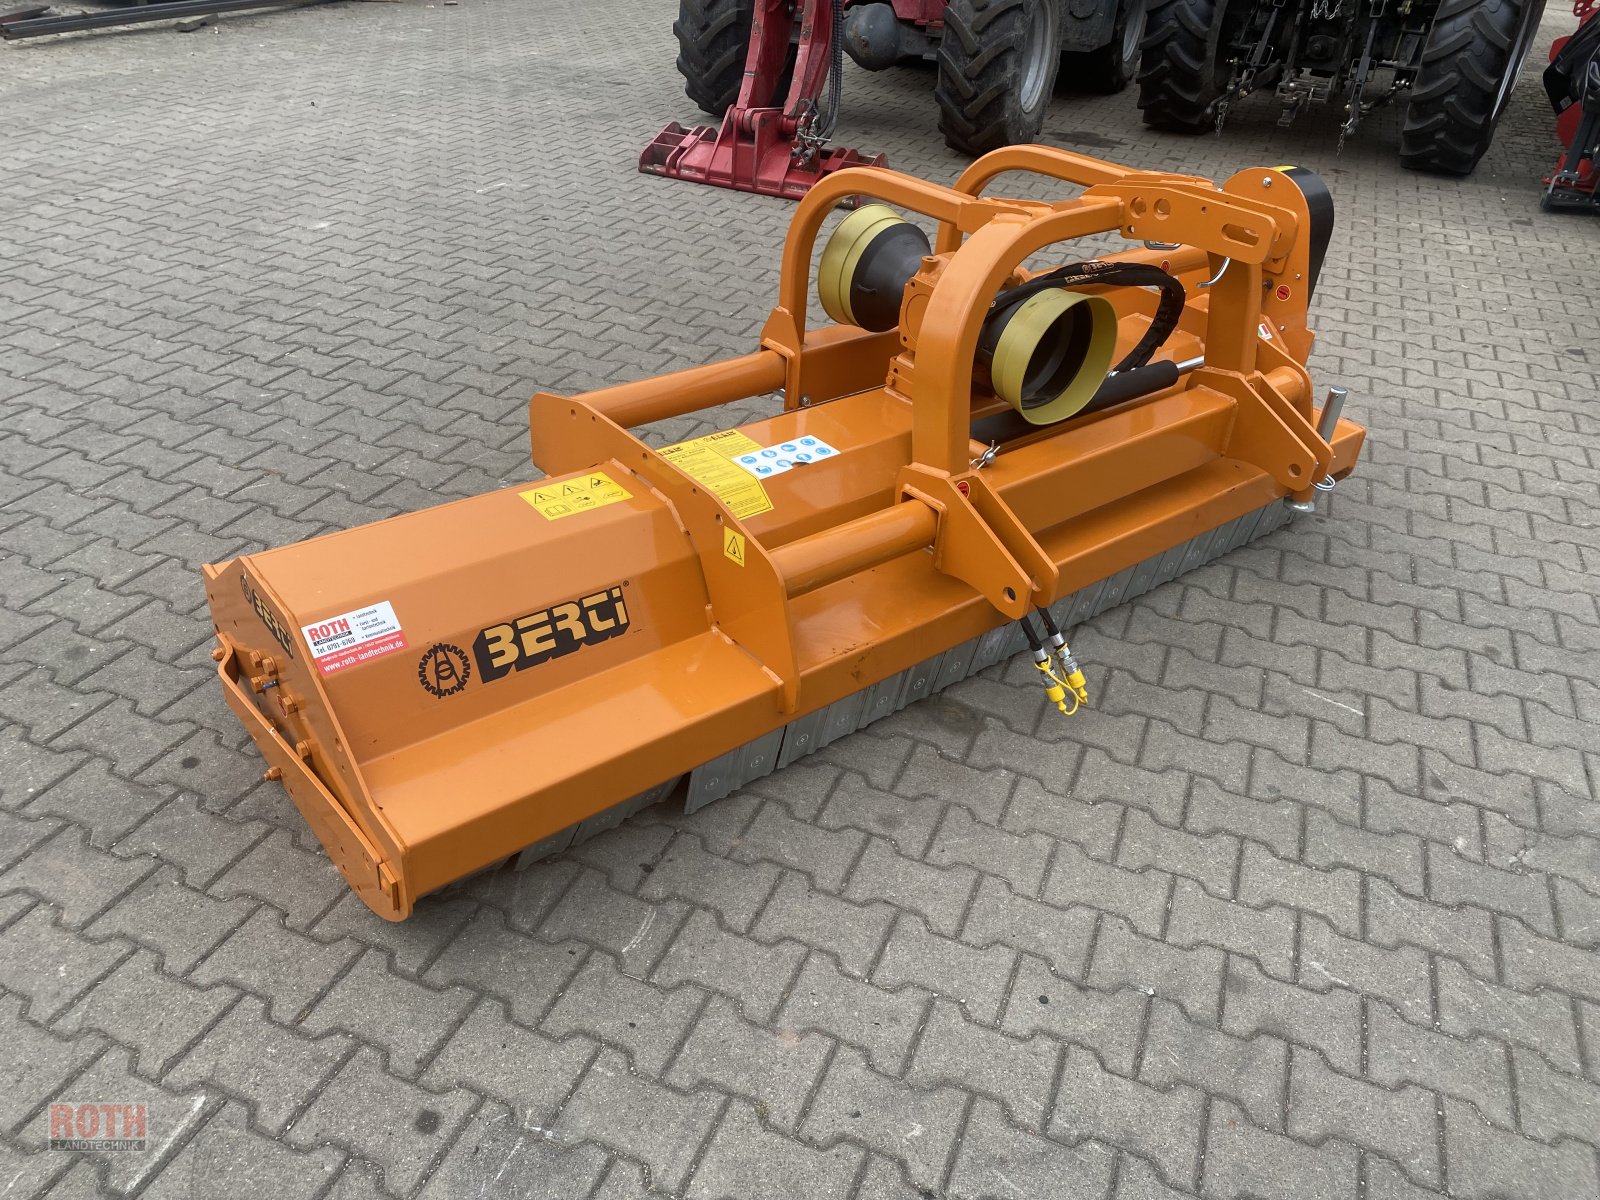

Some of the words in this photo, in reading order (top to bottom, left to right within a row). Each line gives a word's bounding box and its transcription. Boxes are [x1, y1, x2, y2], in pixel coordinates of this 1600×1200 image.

[308, 618, 351, 642] ROTH
[478, 587, 629, 676] BERTI
[316, 645, 327, 655] Tel.
[324, 641, 404, 672] www.roth-landtechnik.de
